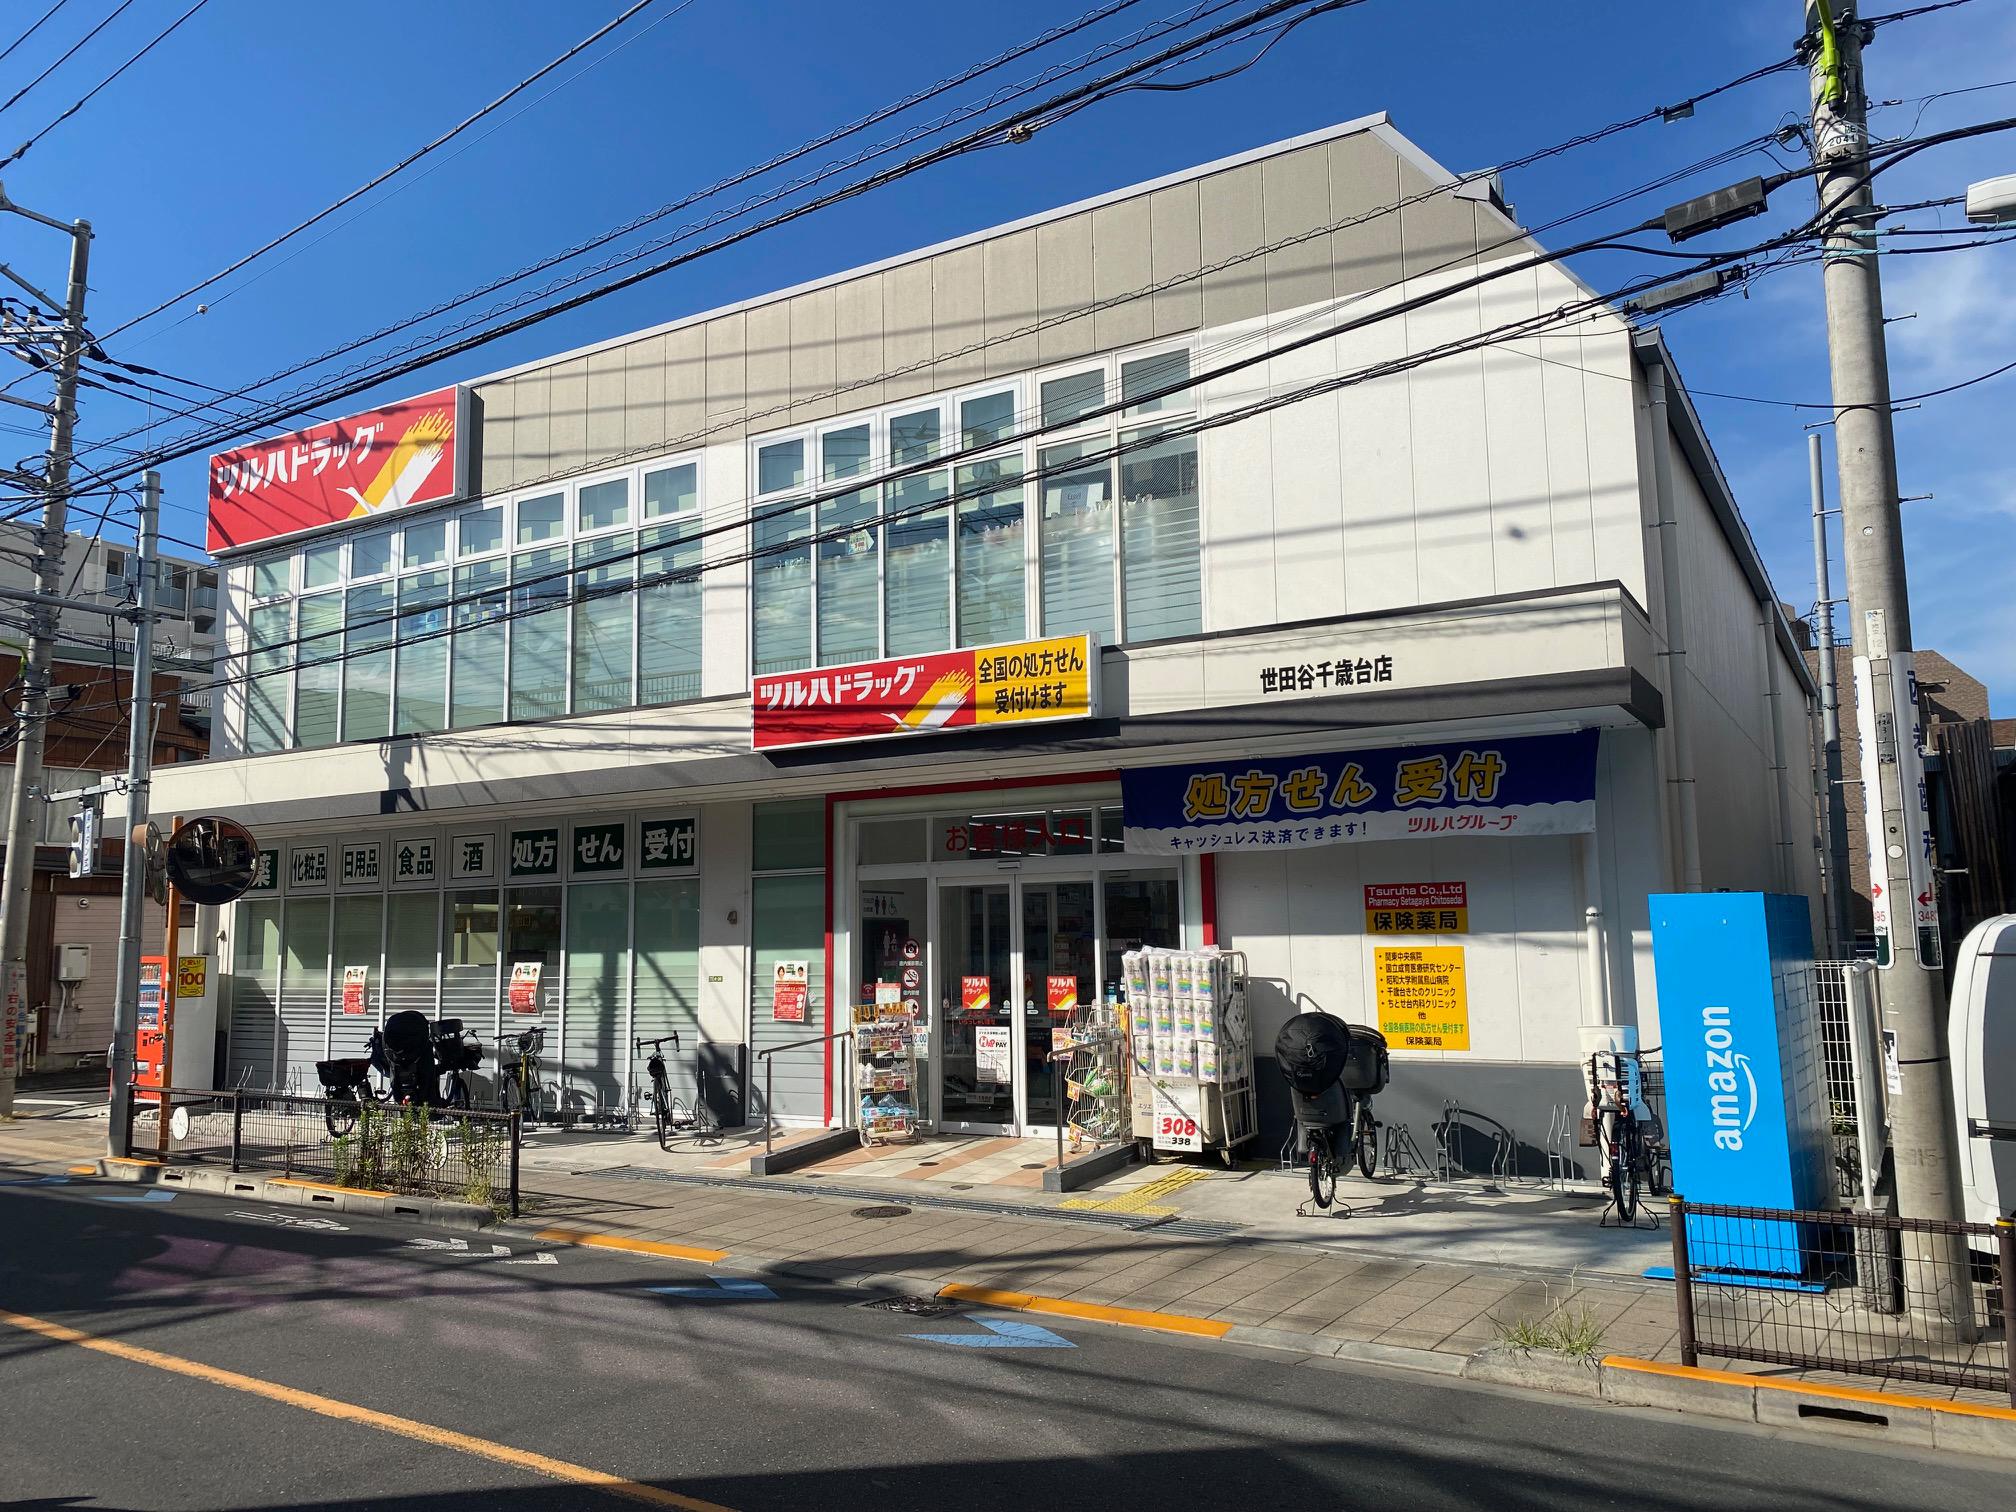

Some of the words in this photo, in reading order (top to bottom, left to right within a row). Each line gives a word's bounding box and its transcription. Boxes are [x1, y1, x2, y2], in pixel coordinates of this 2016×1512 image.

[217, 422, 384, 500] ツルハドラッグ
[978, 647, 1083, 685] 全国の処方せん
[1260, 654, 1393, 695] 世田谷千歳台店
[759, 664, 926, 711] ツルハドラッグ
[994, 681, 1067, 715] 受付けます
[1183, 761, 1377, 822] 処方せん
[1393, 749, 1507, 806] 受付
[1407, 814, 1518, 834] ツルハグループ
[946, 818, 1086, 852] お客様入口
[462, 842, 484, 872] 酒
[512, 836, 557, 869] 処方
[578, 833, 622, 864] せん
[645, 826, 695, 862] 受付
[293, 853, 326, 882] 化粧品
[344, 848, 378, 878] 日用品
[398, 845, 434, 876] 食品
[1368, 886, 1417, 896] Tsuruha
[1419, 884, 1463, 895] Co.,Ltd
[1368, 897, 1400, 907] Pharmacy
[1400, 896, 1430, 906] Setagaya
[1373, 910, 1458, 931] 保険薬局
[1384, 952, 1423, 961] 関東中央病院
[178, 972, 205, 985] 100
[964, 978, 988, 988] ツルハ
[1049, 978, 1074, 988] ツルハ
[1387, 987, 1456, 997] 千歳台きたのクリニック
[1388, 999, 1457, 1009] ちとせ台内科クリニック
[1418, 1011, 1426, 1020] 他
[1405, 1036, 1442, 1046] 保険薬局
[1702, 1005, 1743, 1152] amazon
[1162, 1117, 1196, 1137] 308
[1172, 1137, 1191, 1146] 338
